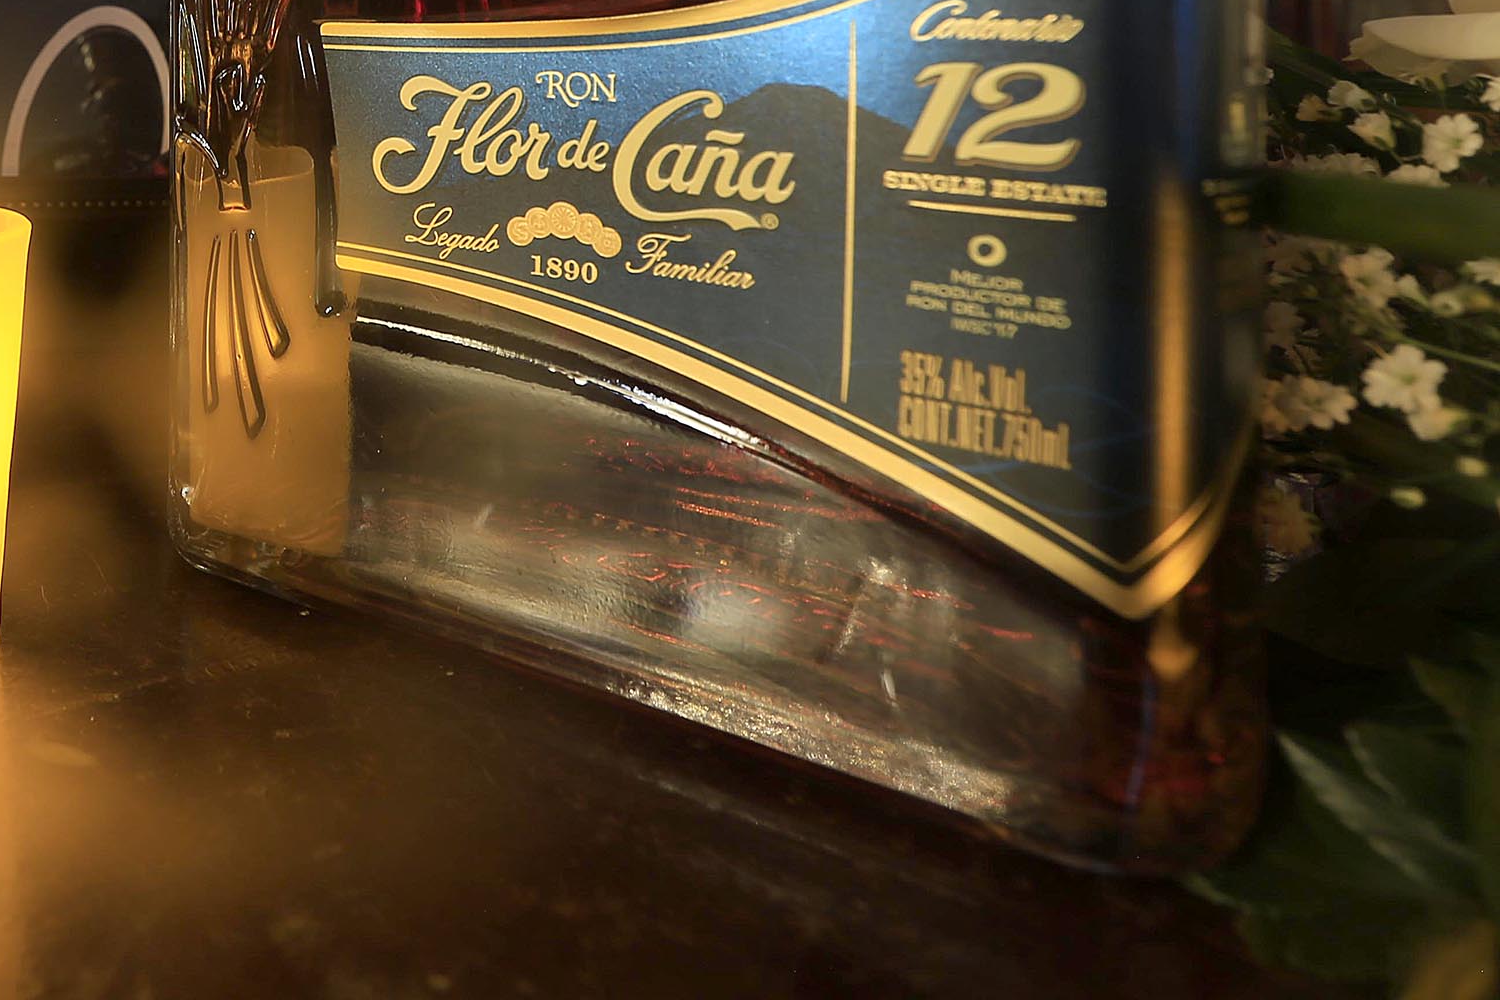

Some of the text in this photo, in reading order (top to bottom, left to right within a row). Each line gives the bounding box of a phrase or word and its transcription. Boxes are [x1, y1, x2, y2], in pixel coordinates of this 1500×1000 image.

[909, 0, 1085, 43] Centenario
[535, 70, 616, 107] RON
[902, 61, 1086, 172] 12
[372, 75, 795, 231] Flor de Caña
[883, 169, 1108, 208] SINGLE ESTATE
[405, 203, 755, 289] Legado Familiar
[530, 255, 598, 283] 1890
